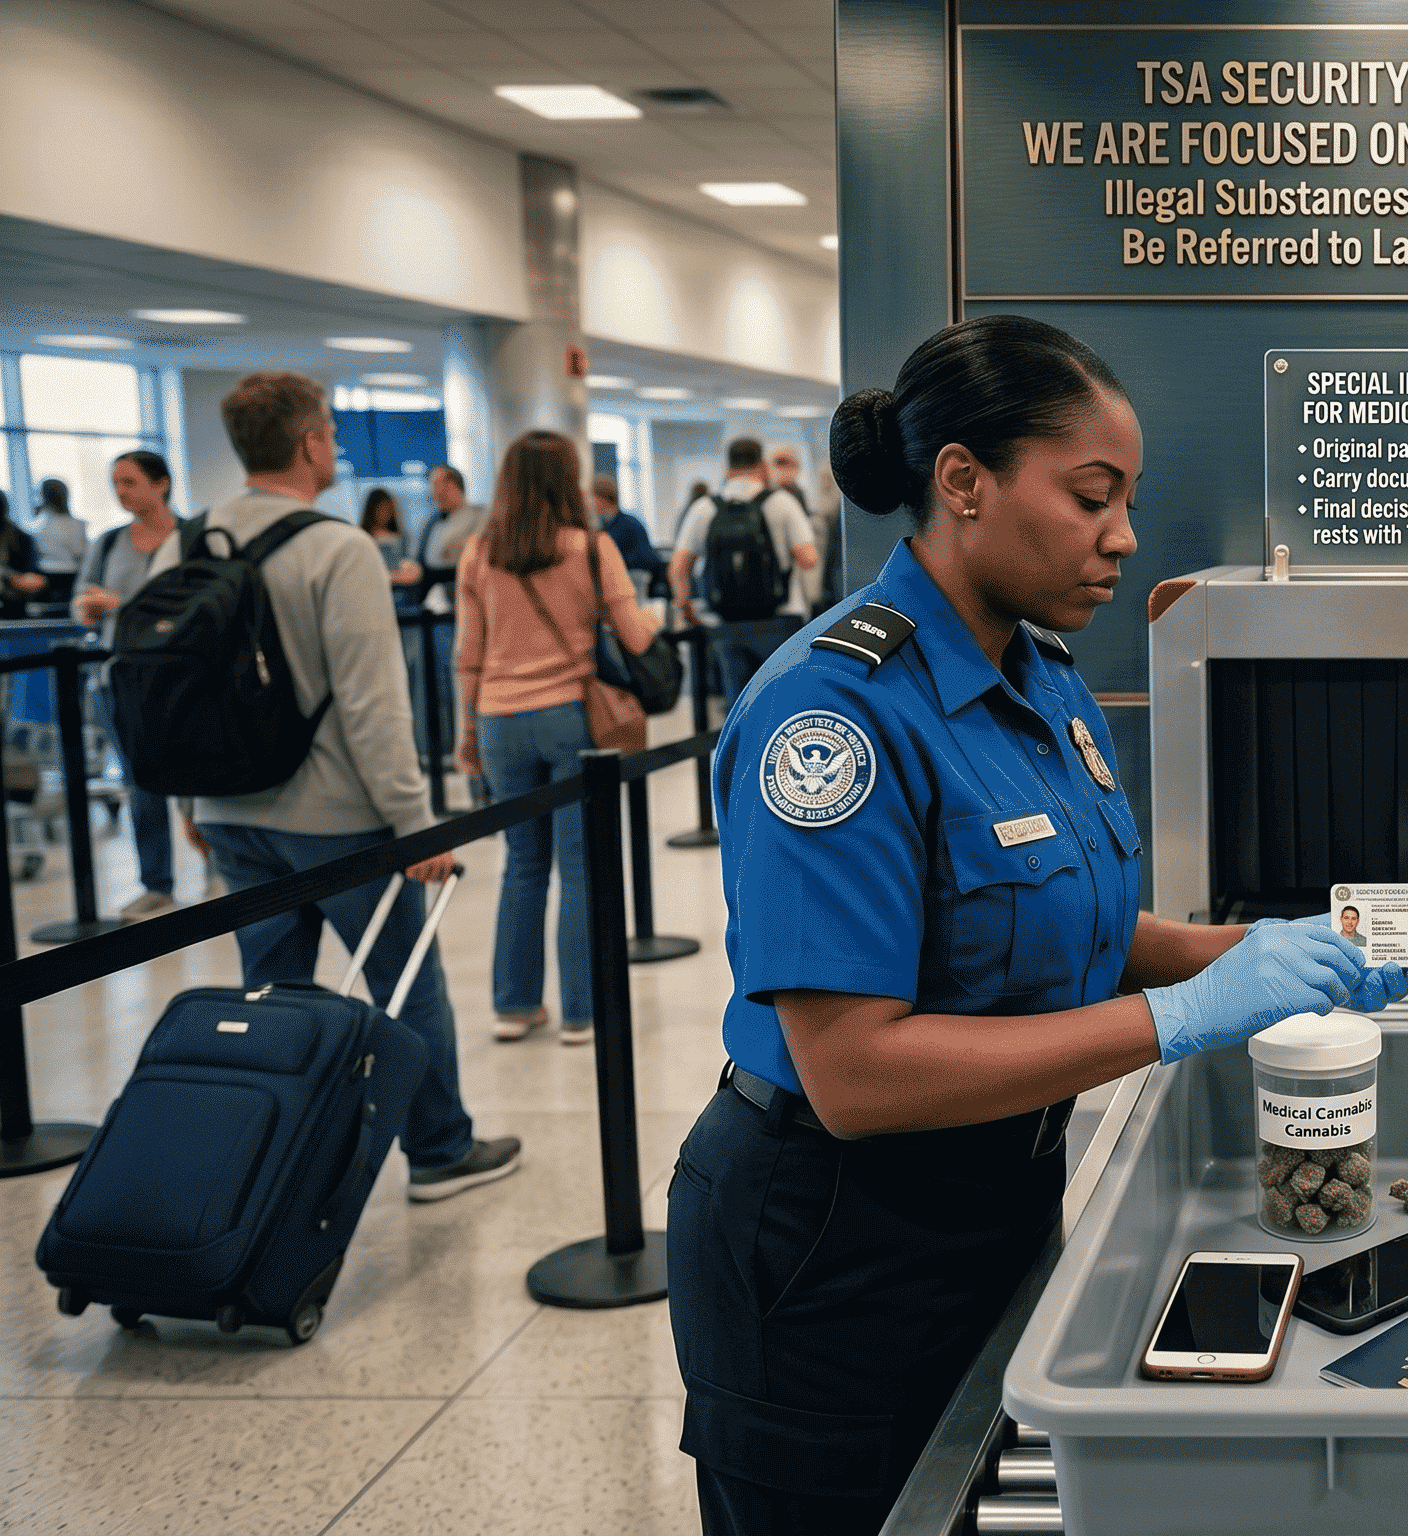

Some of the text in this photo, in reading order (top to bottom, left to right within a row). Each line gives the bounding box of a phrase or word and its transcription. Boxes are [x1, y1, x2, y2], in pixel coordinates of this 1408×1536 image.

[1138, 61, 1211, 104] TSA
[1222, 61, 1408, 104] SECURITY
[1022, 122, 1083, 164] WE
[1094, 122, 1169, 164] ARE
[1182, 122, 1357, 165] FOCUSED
[1105, 179, 1204, 223] Illegal
[1123, 229, 1165, 264] Be
[1176, 228, 1319, 265] Referred
[1328, 231, 1362, 265] to
[1307, 371, 1394, 395] SPECIAL
[1303, 401, 1343, 424] FOR
[1313, 438, 1382, 462] Original
[1313, 468, 1362, 492] Carry
[1313, 498, 1356, 519] Final
[1313, 525, 1359, 545] rests
[1363, 524, 1402, 544] with
[1262, 1098, 1372, 1120] Medical Cannabis
[1285, 1123, 1352, 1137] Cannabis
